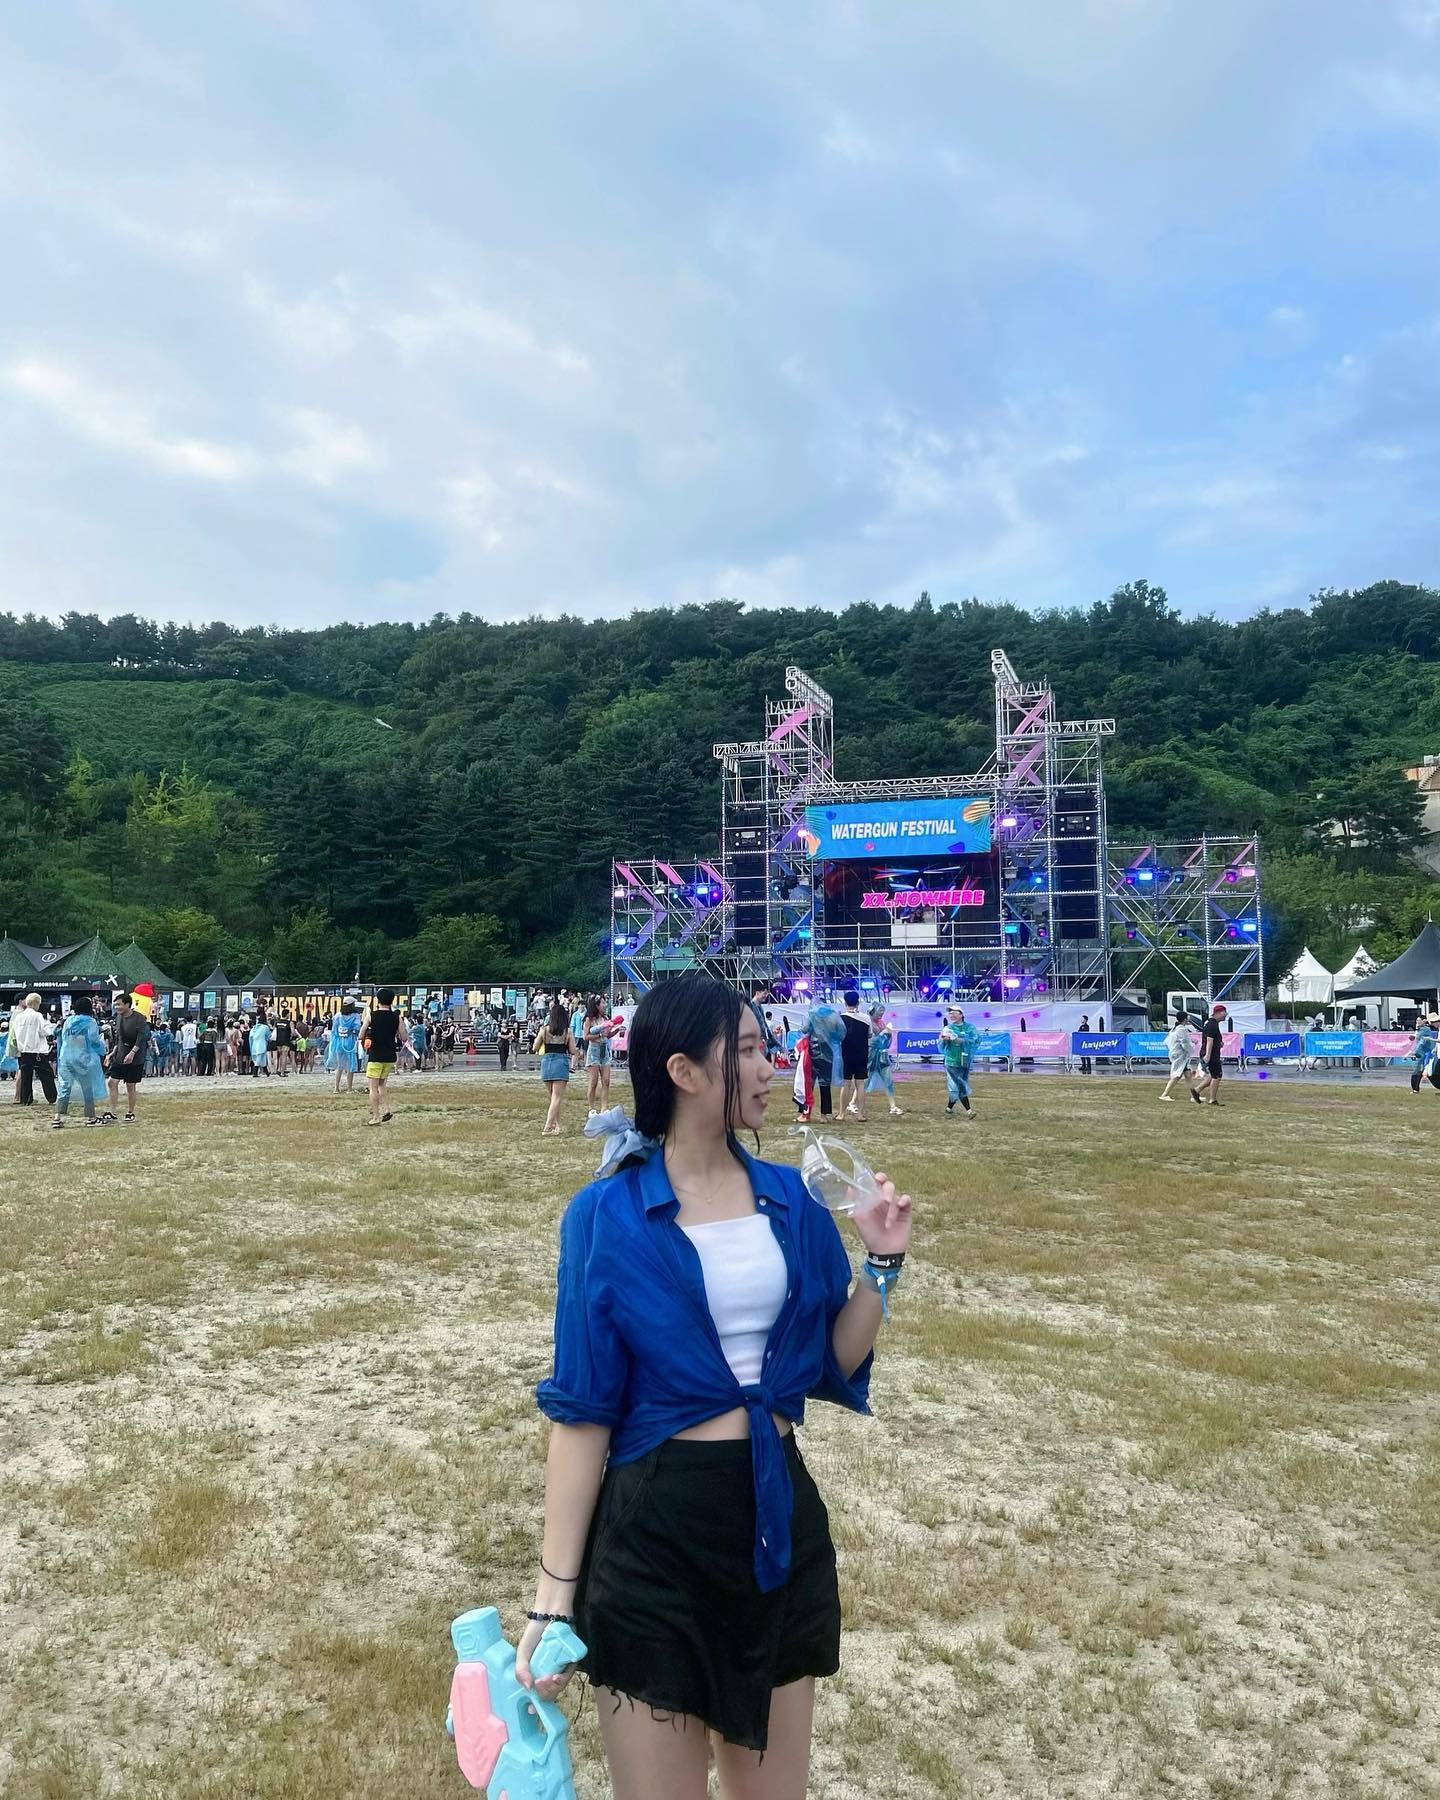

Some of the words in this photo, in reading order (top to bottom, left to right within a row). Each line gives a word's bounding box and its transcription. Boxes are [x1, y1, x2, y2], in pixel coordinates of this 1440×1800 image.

[831, 821, 897, 840] WATERGUN
[900, 819, 957, 837] FESTIVAL
[861, 890, 984, 908] XX.NOWHERE
